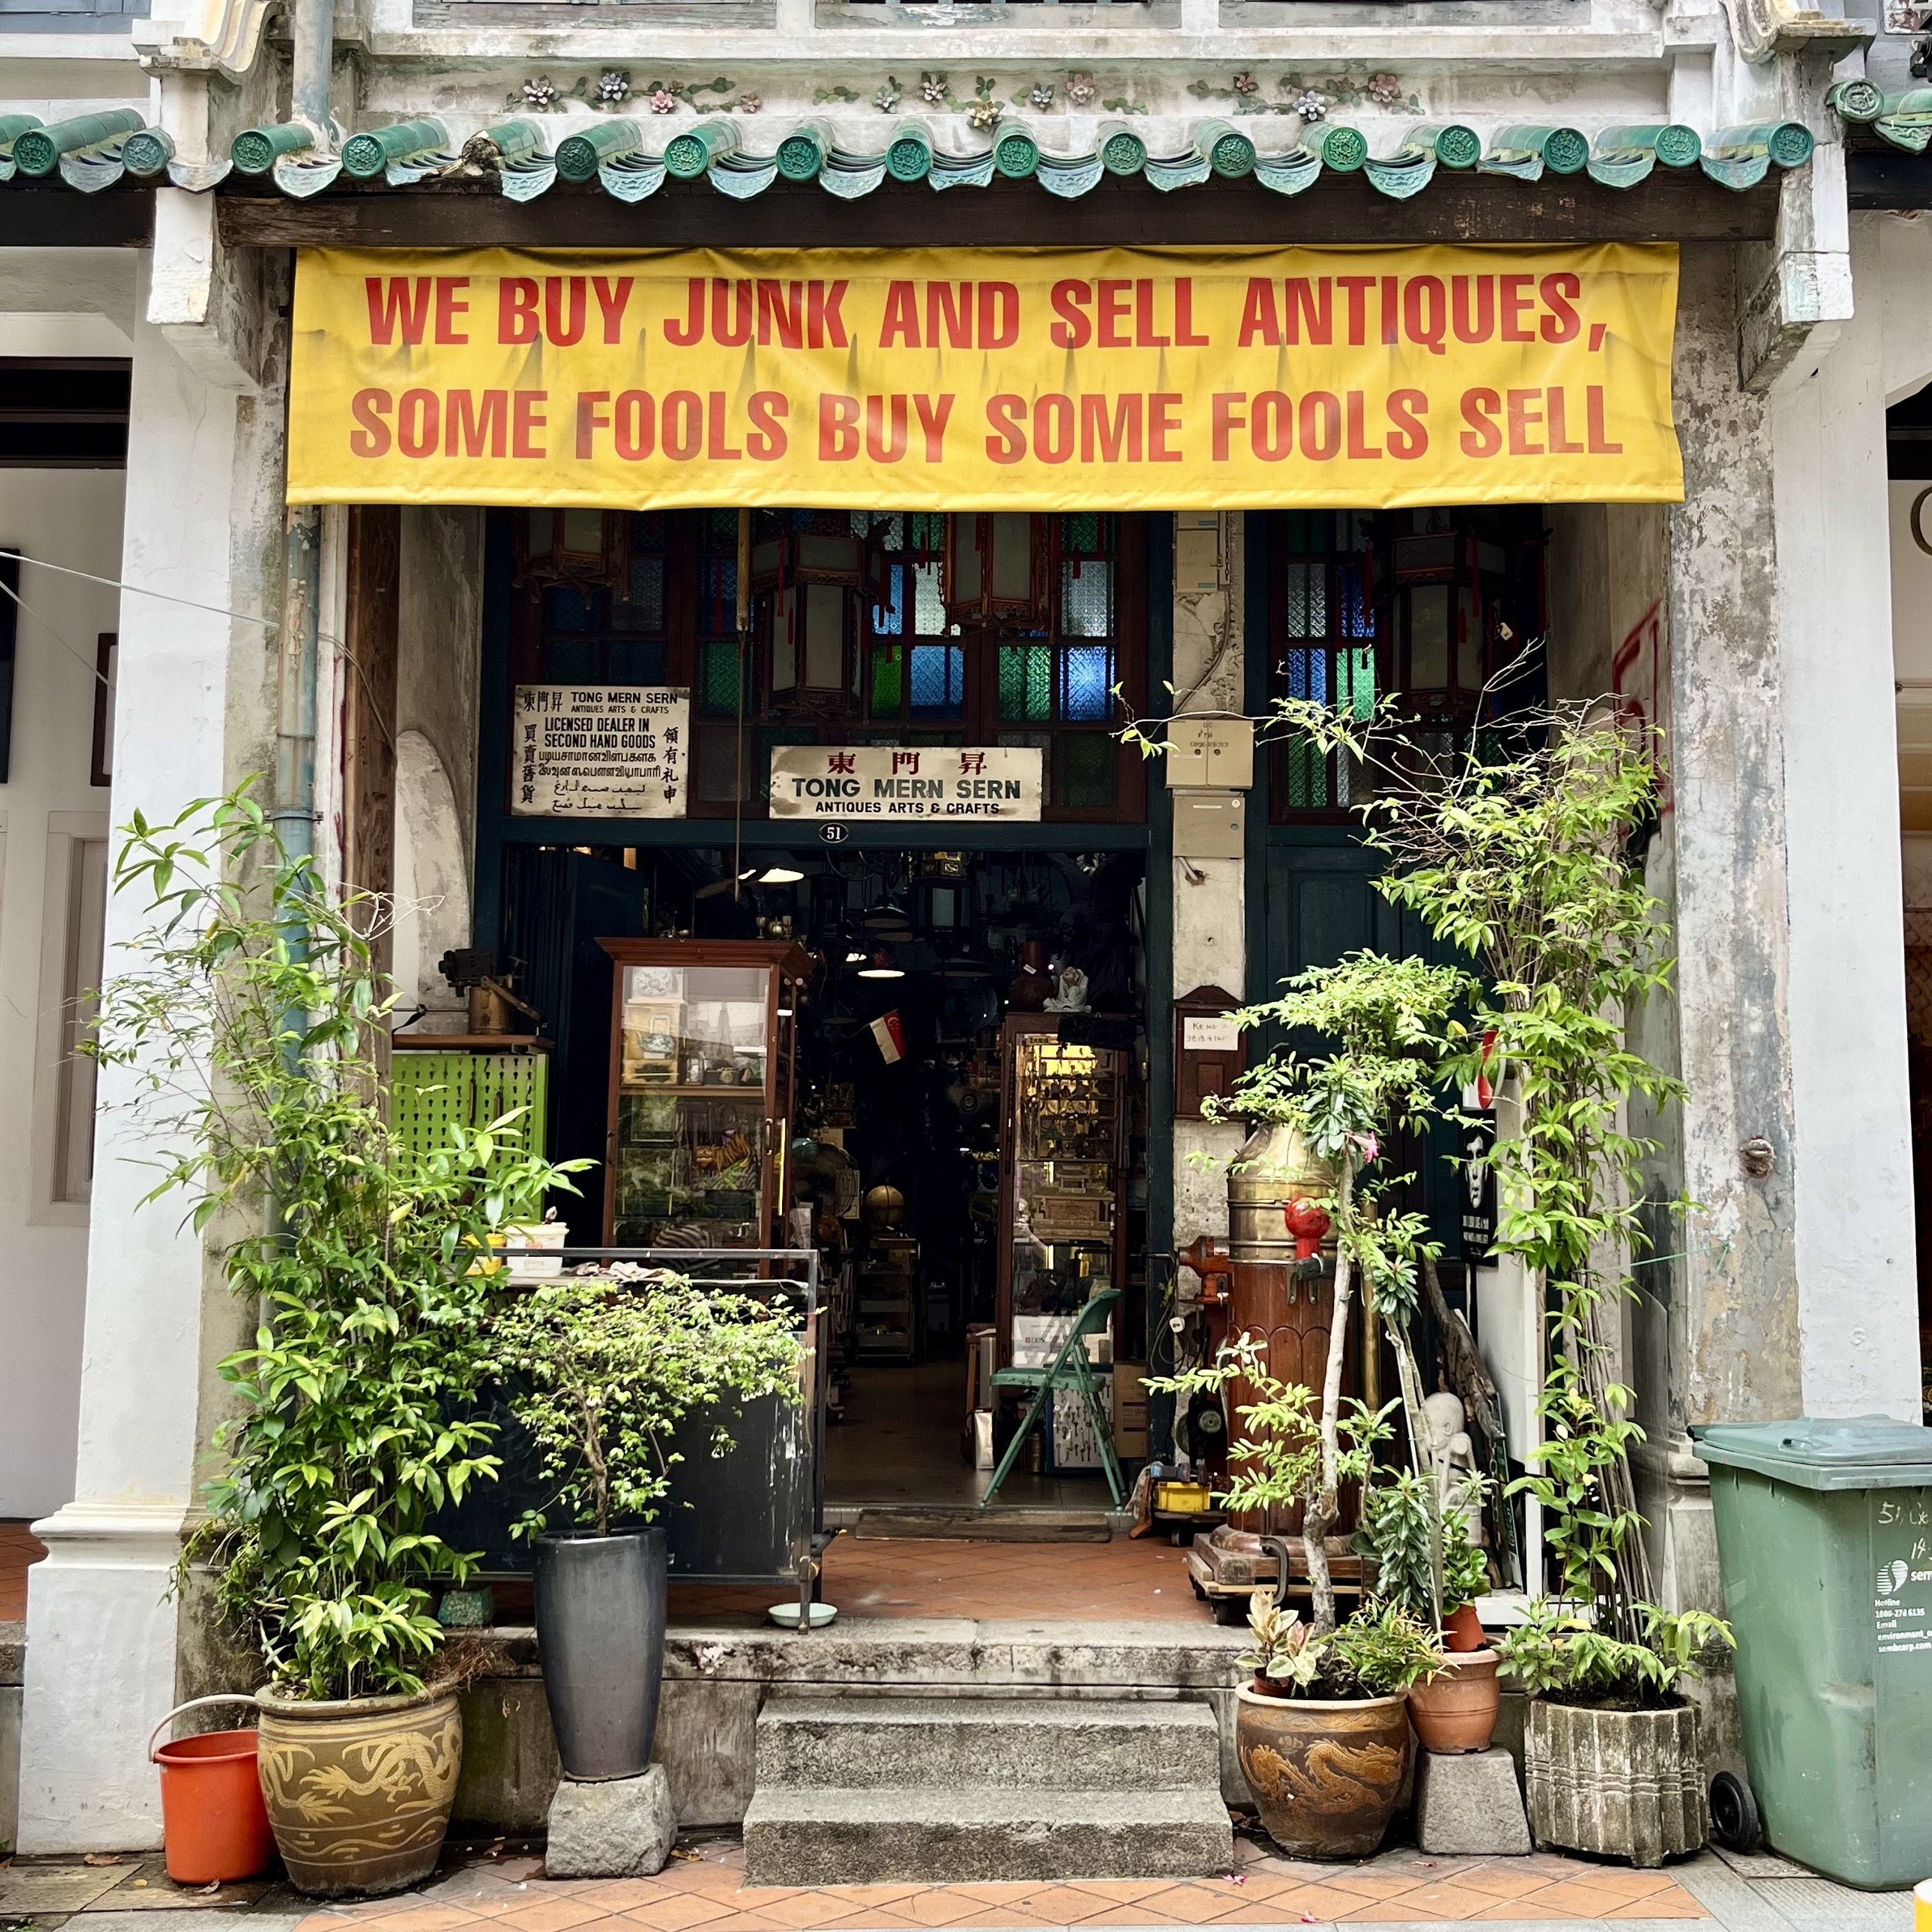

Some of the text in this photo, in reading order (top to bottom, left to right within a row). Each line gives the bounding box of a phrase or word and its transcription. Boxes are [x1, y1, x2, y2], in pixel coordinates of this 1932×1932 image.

[365, 272, 1607, 356] WE BUY JUNK AND SELL ANTIQUES,
[350, 385, 1623, 464] SOME FOOLS BUY SOME FOOLS SELL
[523, 691, 563, 712] 東門昇
[571, 692, 678, 704] TONG MERN SERN
[571, 705, 604, 714] ANTIQUES
[544, 717, 650, 732] LICENSED DEALER IN
[544, 733, 656, 749] SECOND HAND GOODS
[792, 778, 1020, 799] TONG MERN SERN
[815, 801, 1000, 815] ANTIQUES ARTS & CRAFTS
[827, 826, 841, 840] 51
[1874, 1598, 1901, 1607] Hotline
[1876, 1619, 1897, 1629] Email
